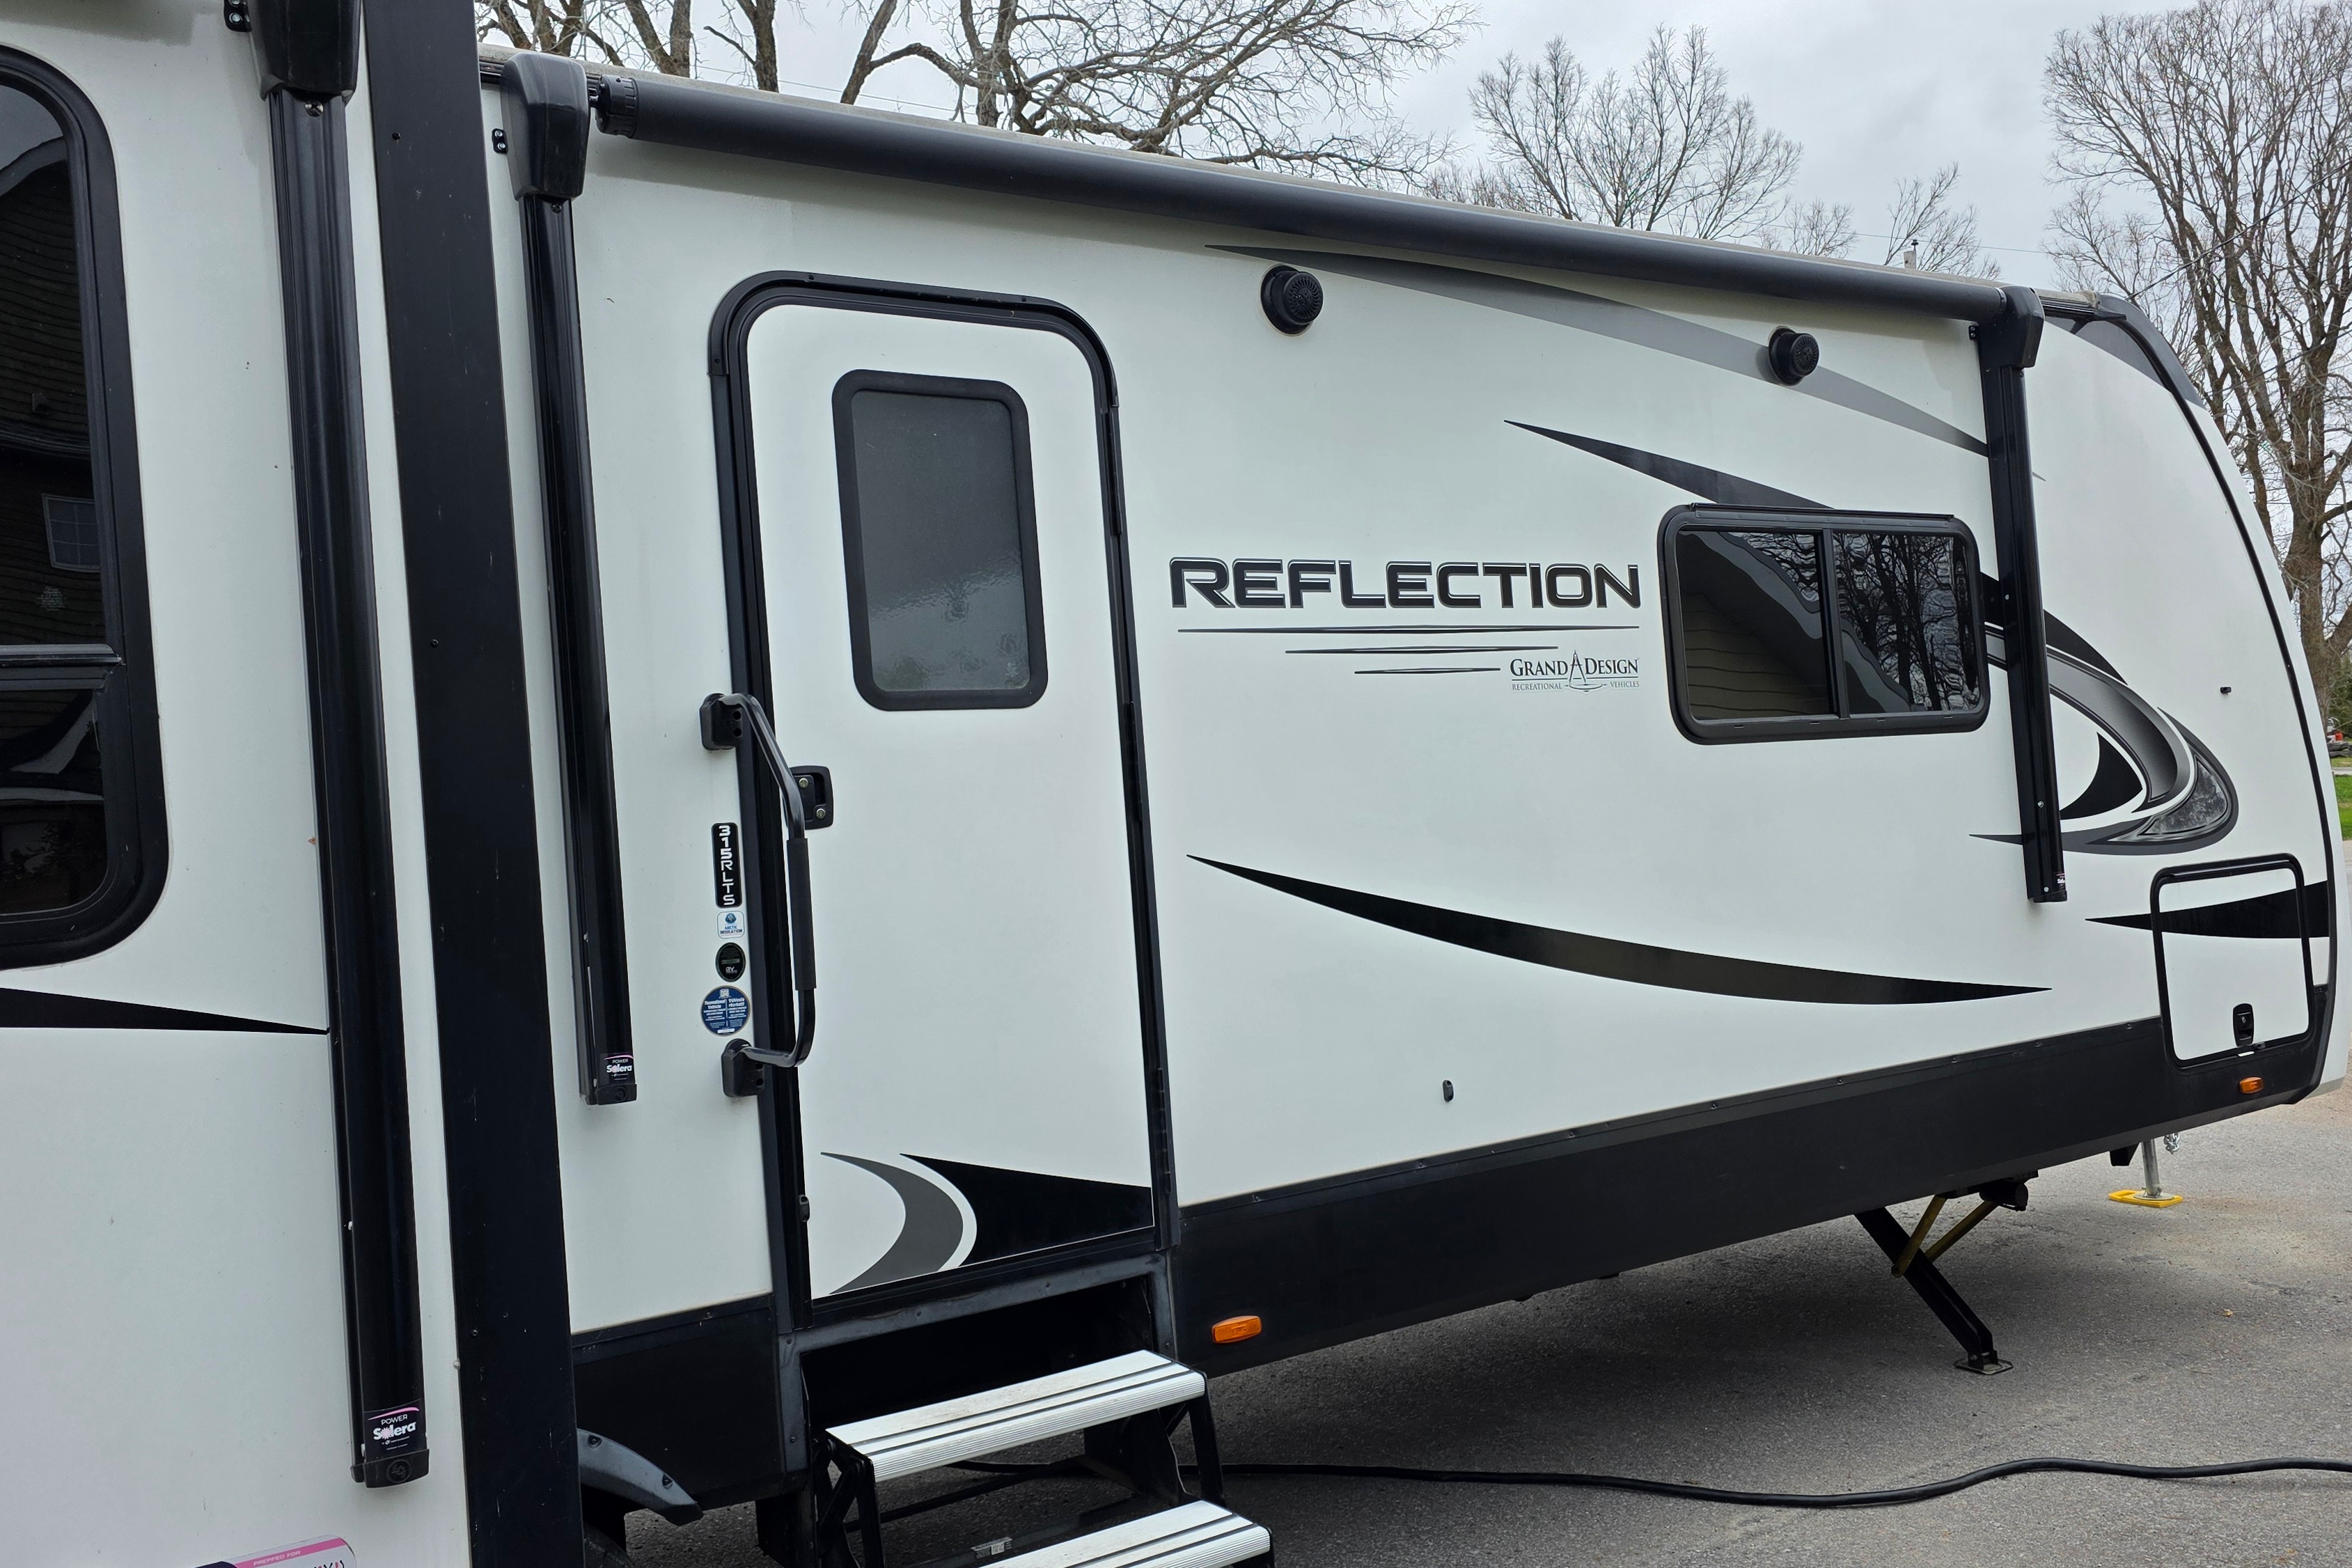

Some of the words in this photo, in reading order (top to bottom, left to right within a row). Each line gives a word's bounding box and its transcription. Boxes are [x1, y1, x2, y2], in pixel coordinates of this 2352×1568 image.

[1169, 557, 1641, 609] REFLECTION
[1510, 658, 1569, 677] GRAND
[1583, 657, 1639, 675] DESIGN
[1512, 682, 1562, 691] RECREATIONAL
[1610, 680, 1640, 689] VEHICLES
[719, 824, 735, 905] 315RLTS
[381, 1414, 408, 1425] POWER
[253, 1553, 285, 1566] PREPPED
[287, 1550, 301, 1558] FOR
